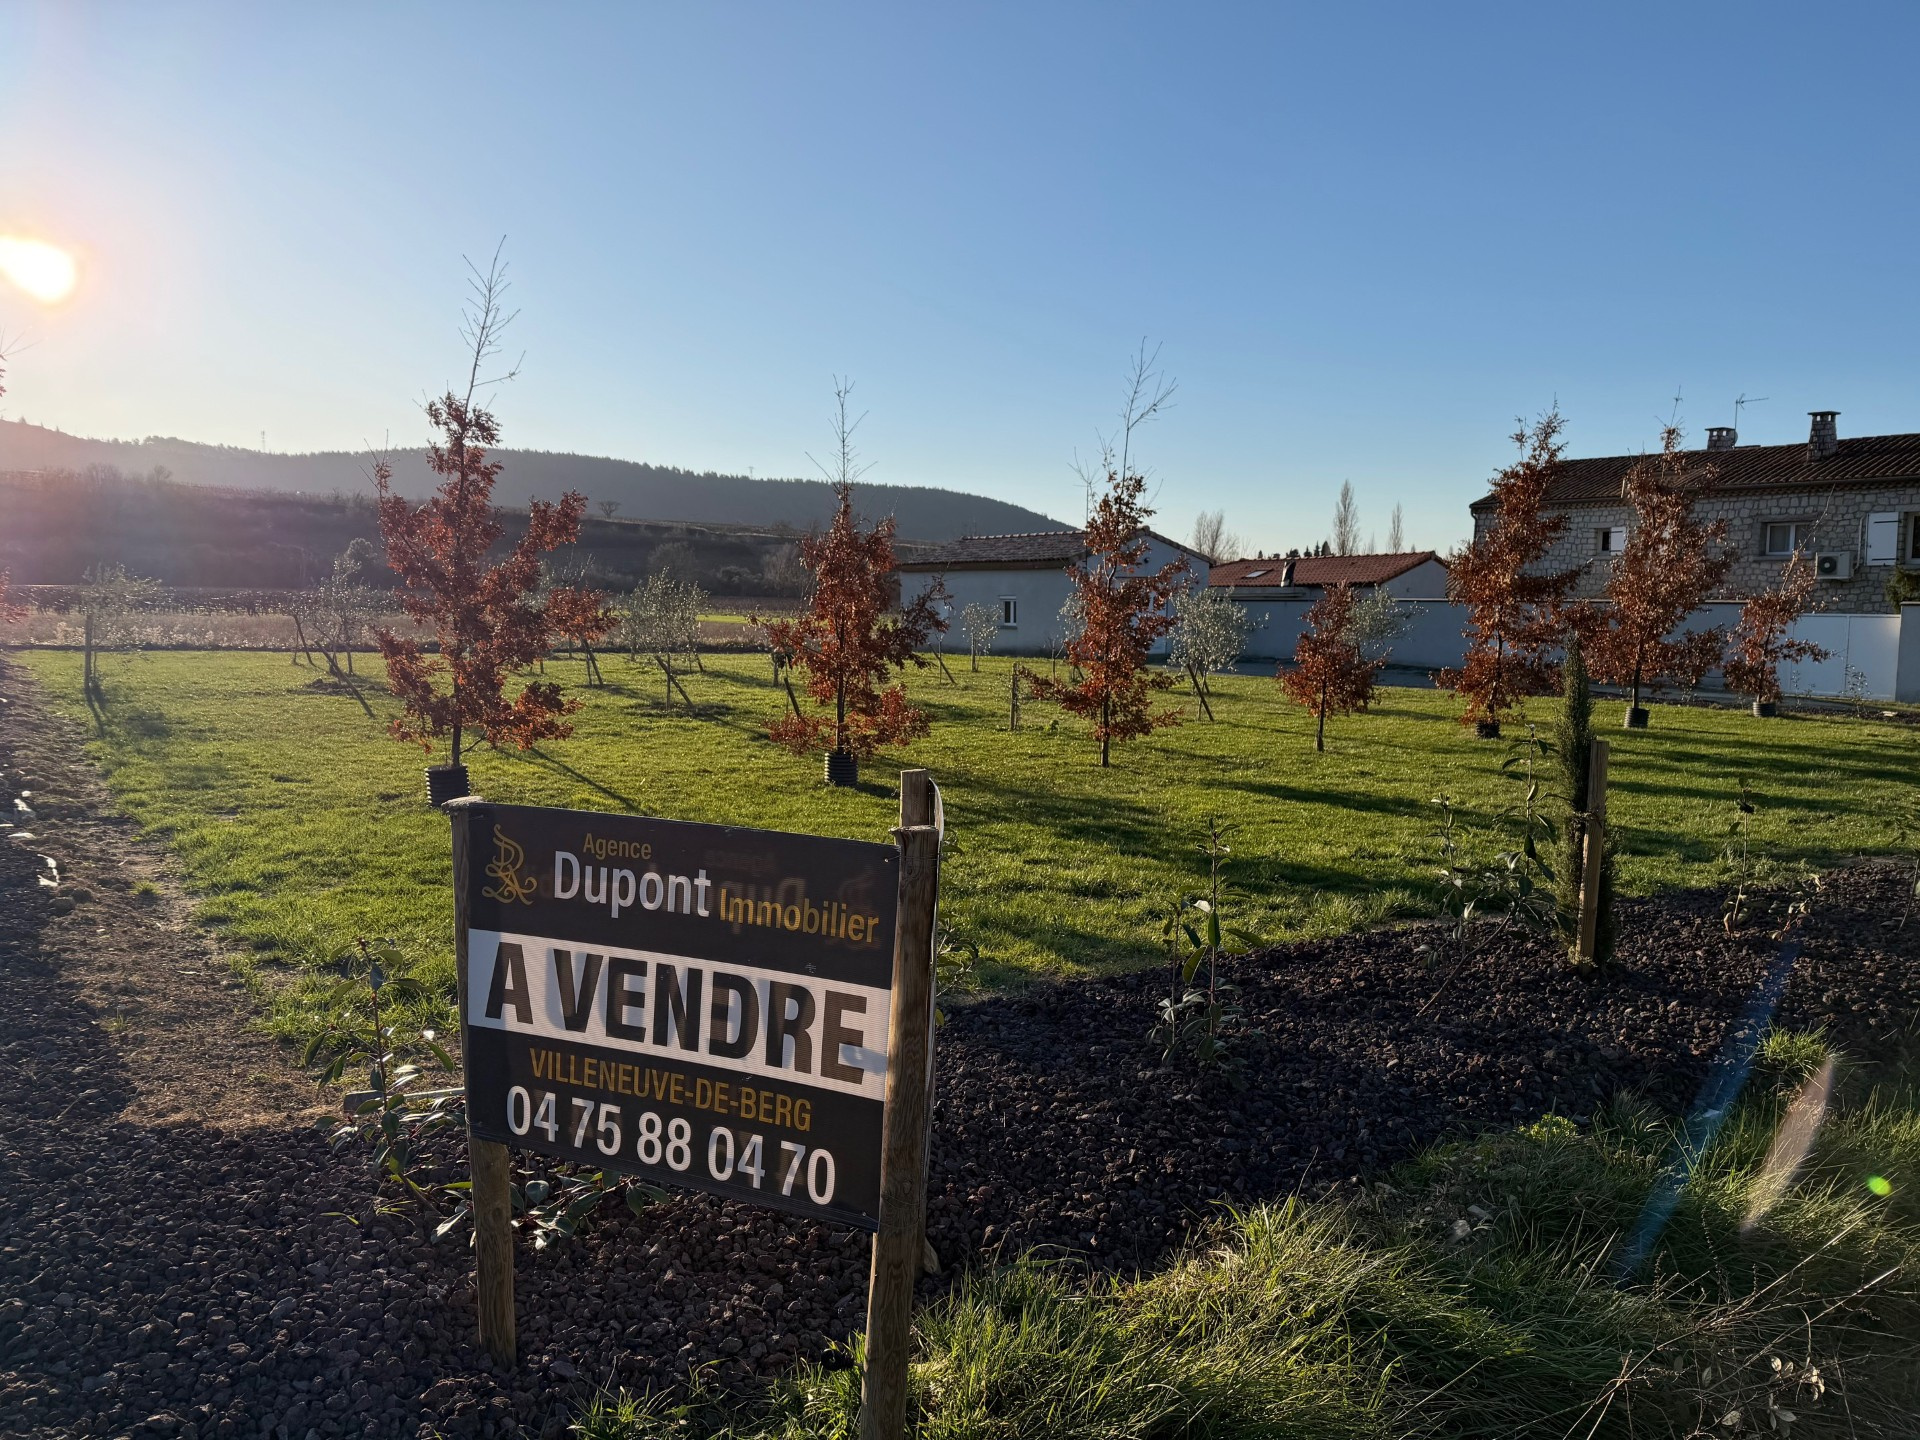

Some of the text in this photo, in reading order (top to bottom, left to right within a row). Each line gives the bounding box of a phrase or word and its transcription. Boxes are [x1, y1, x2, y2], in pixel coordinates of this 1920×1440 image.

[583, 832, 652, 860] Agence
[554, 850, 712, 919] Dupont
[719, 888, 879, 943] Immobilier
[484, 941, 868, 1085] A VENDRE
[529, 1047, 812, 1132] VILLENEUVE-DE-BERG
[506, 1085, 836, 1206] 04 75 88 04 70
